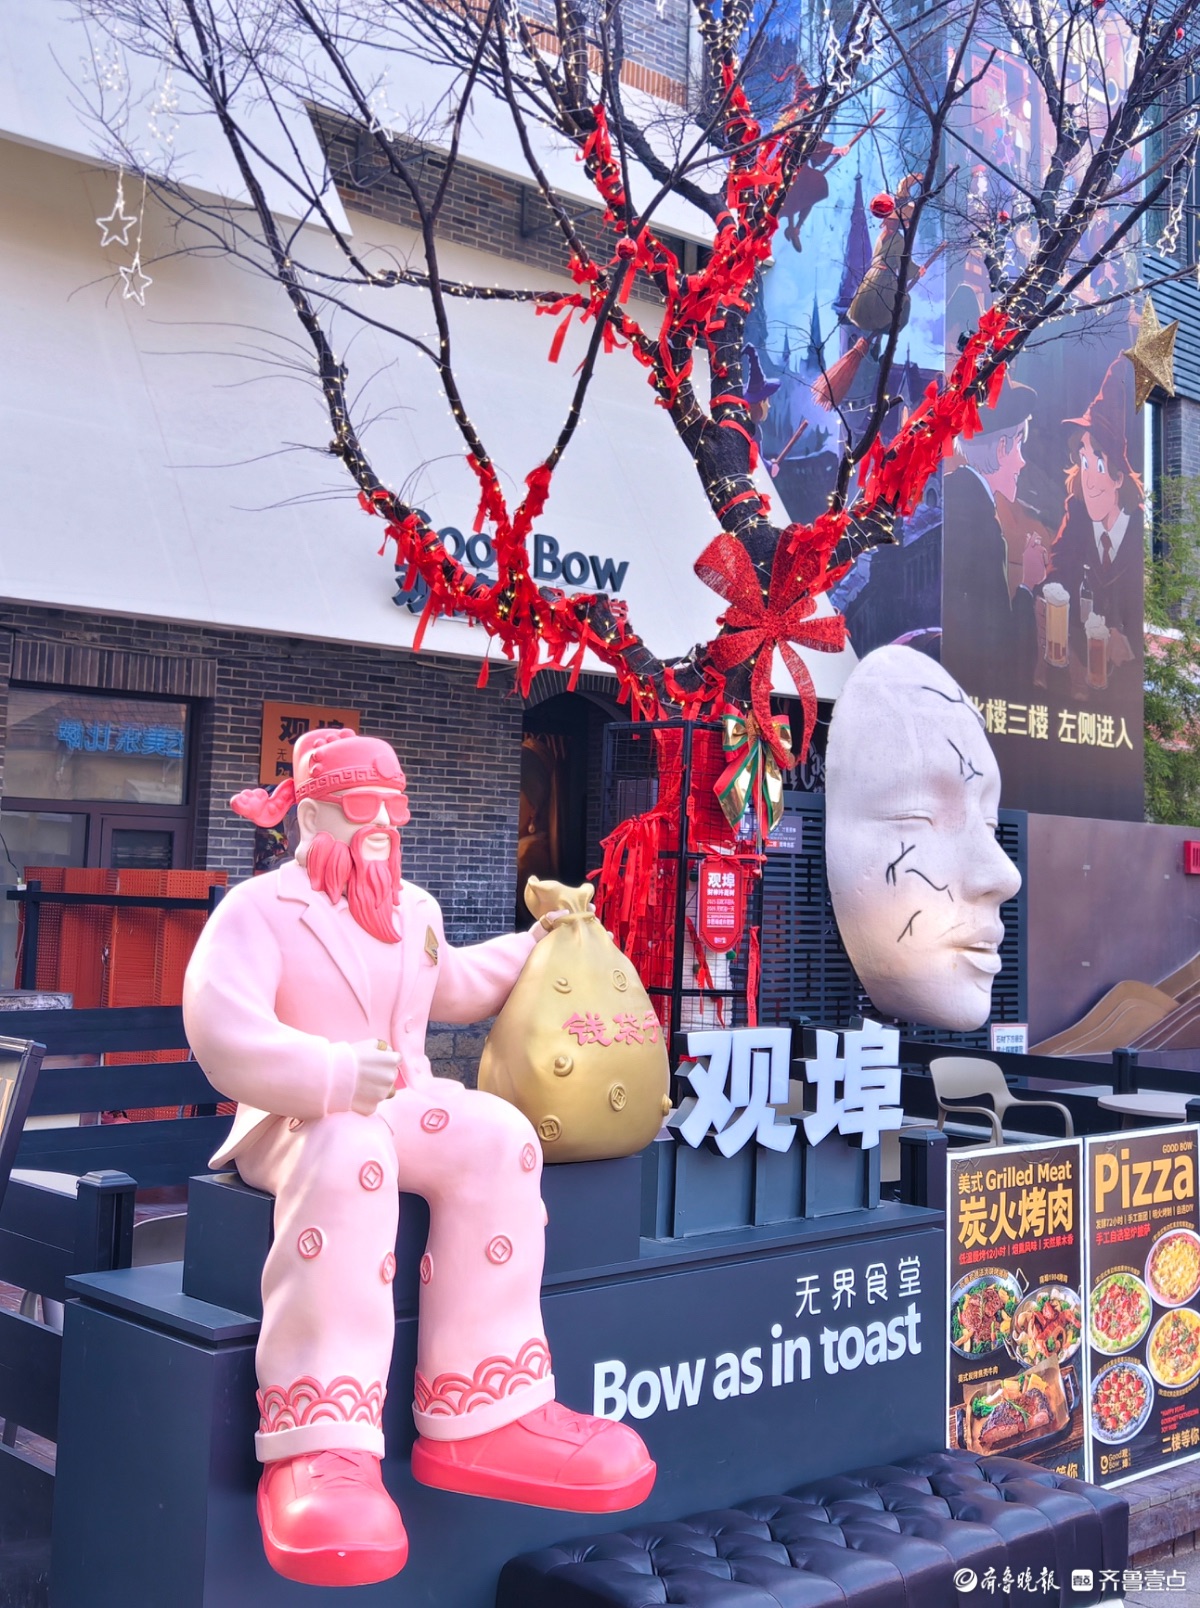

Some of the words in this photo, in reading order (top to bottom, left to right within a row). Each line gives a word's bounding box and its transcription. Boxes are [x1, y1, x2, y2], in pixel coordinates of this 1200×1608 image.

[413, 508, 526, 569] oo
[533, 533, 630, 593] Bow
[1058, 709, 1134, 750] 左侧进入
[707, 872, 735, 888] 观埠
[561, 1010, 661, 1047] 钱袋子
[672, 1018, 904, 1159] 观埠
[1162, 1143, 1179, 1154] GOOD
[1180, 1141, 1194, 1152] BOW
[958, 1171, 983, 1195] 美式
[985, 1163, 1034, 1191] Grilled
[1037, 1160, 1073, 1183] Meat
[1095, 1148, 1194, 1214] Pizza
[957, 1183, 1074, 1249] 炭火烤肉
[795, 1255, 922, 1318] 无界食堂
[593, 1358, 706, 1422] Bow
[712, 1346, 764, 1401] as
[771, 1323, 811, 1387] in
[820, 1302, 922, 1375] toast
[1161, 1426, 1200, 1454] 二楼等你
